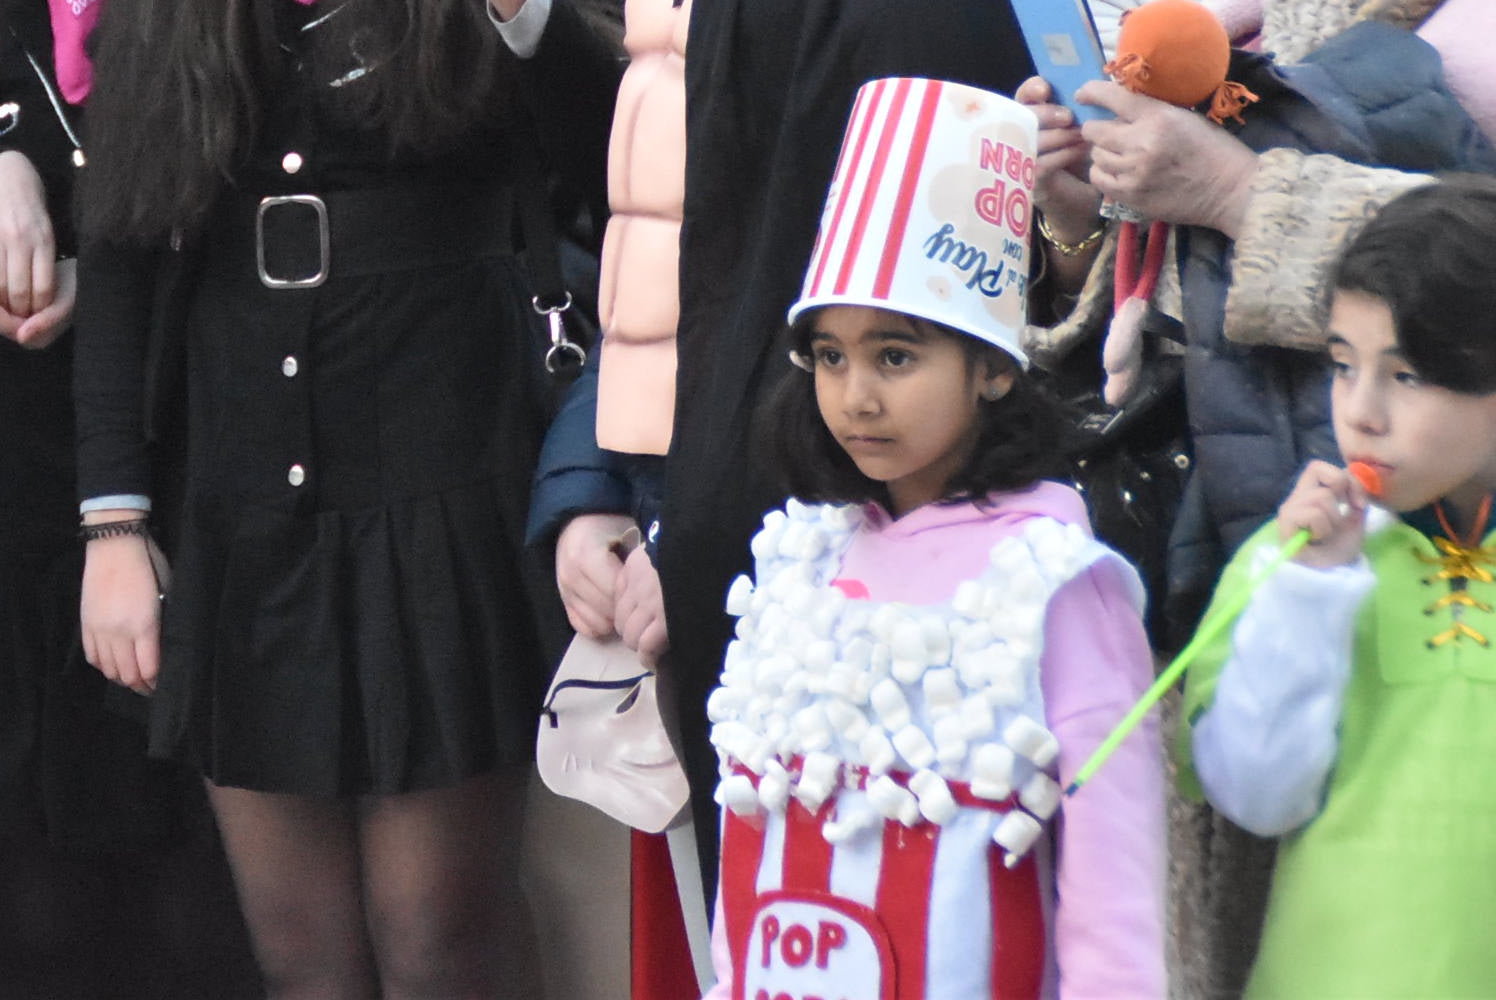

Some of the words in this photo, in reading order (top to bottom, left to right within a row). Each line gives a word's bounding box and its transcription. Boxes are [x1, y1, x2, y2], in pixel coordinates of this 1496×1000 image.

[980, 138, 1035, 190] ORN
[975, 178, 1031, 240] OP
[923, 223, 1004, 298] Play
[761, 914, 848, 971] POP
